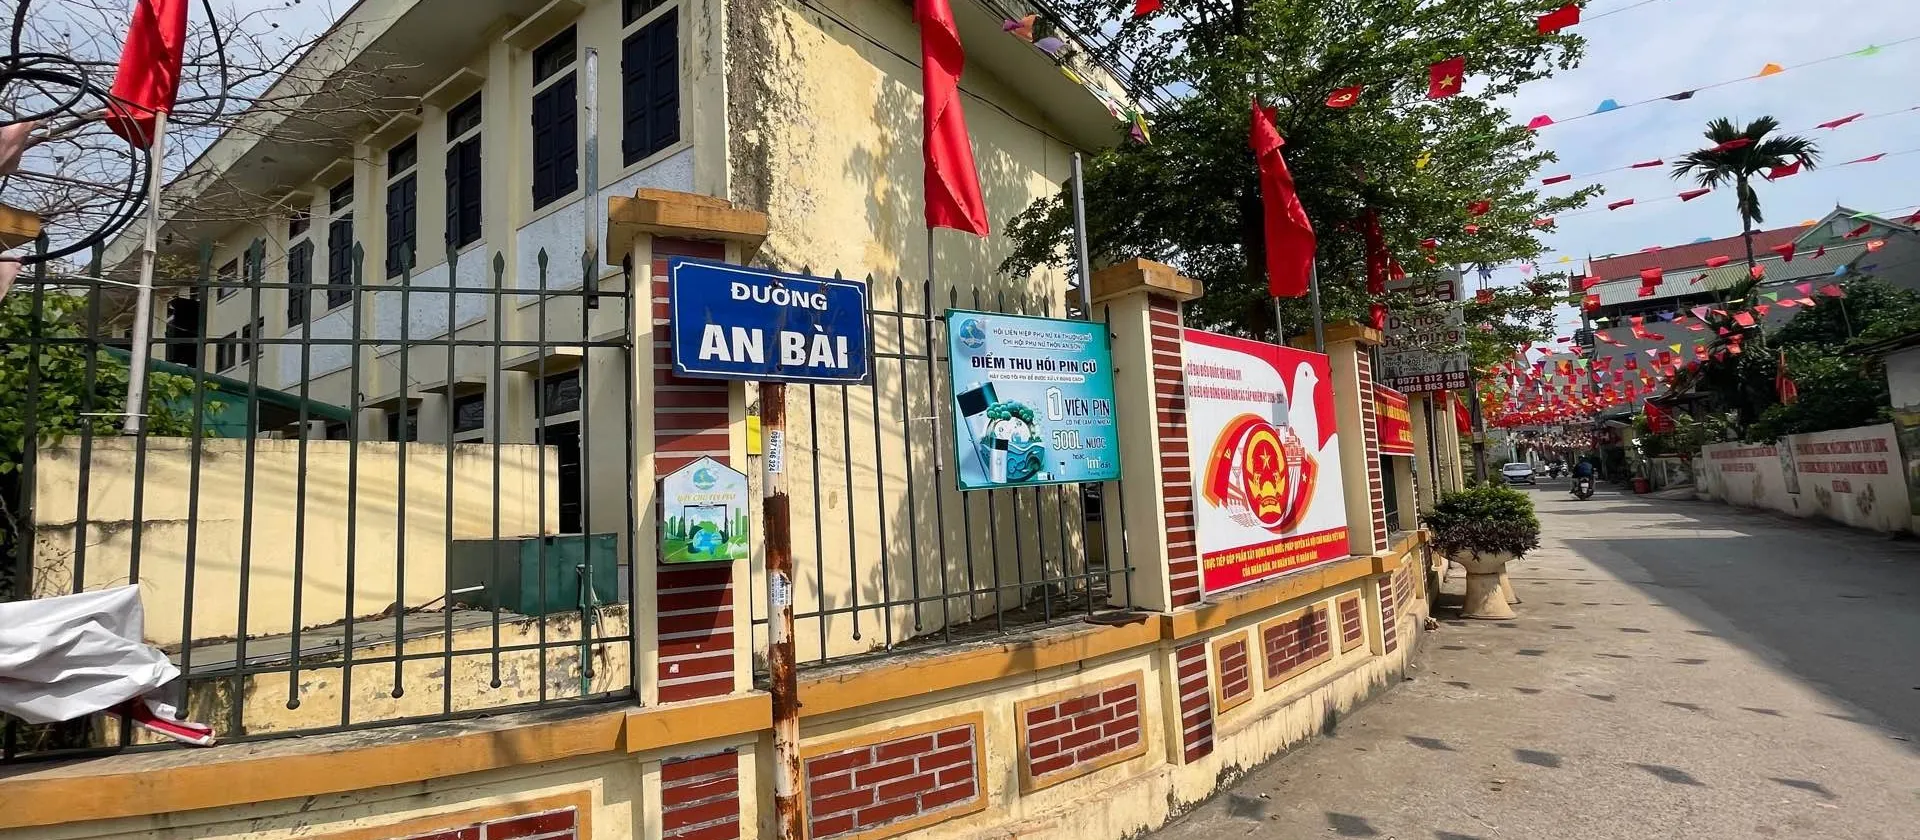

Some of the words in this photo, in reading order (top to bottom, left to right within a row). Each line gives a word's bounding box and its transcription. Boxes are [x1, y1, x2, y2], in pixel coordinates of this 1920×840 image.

[731, 281, 828, 311] ĐƯỜNG
[698, 323, 765, 364] AN
[780, 324, 849, 369] BÀI
[972, 352, 1005, 370] ĐIỂM
[1009, 358, 1032, 370] THU
[1060, 361, 1079, 373] PIN
[1424, 374, 1443, 382] 812
[1065, 398, 1089, 416] VIÊN
[1093, 399, 1110, 416] PIN
[1052, 430, 1083, 450] 500L
[768, 460, 776, 472] 324
